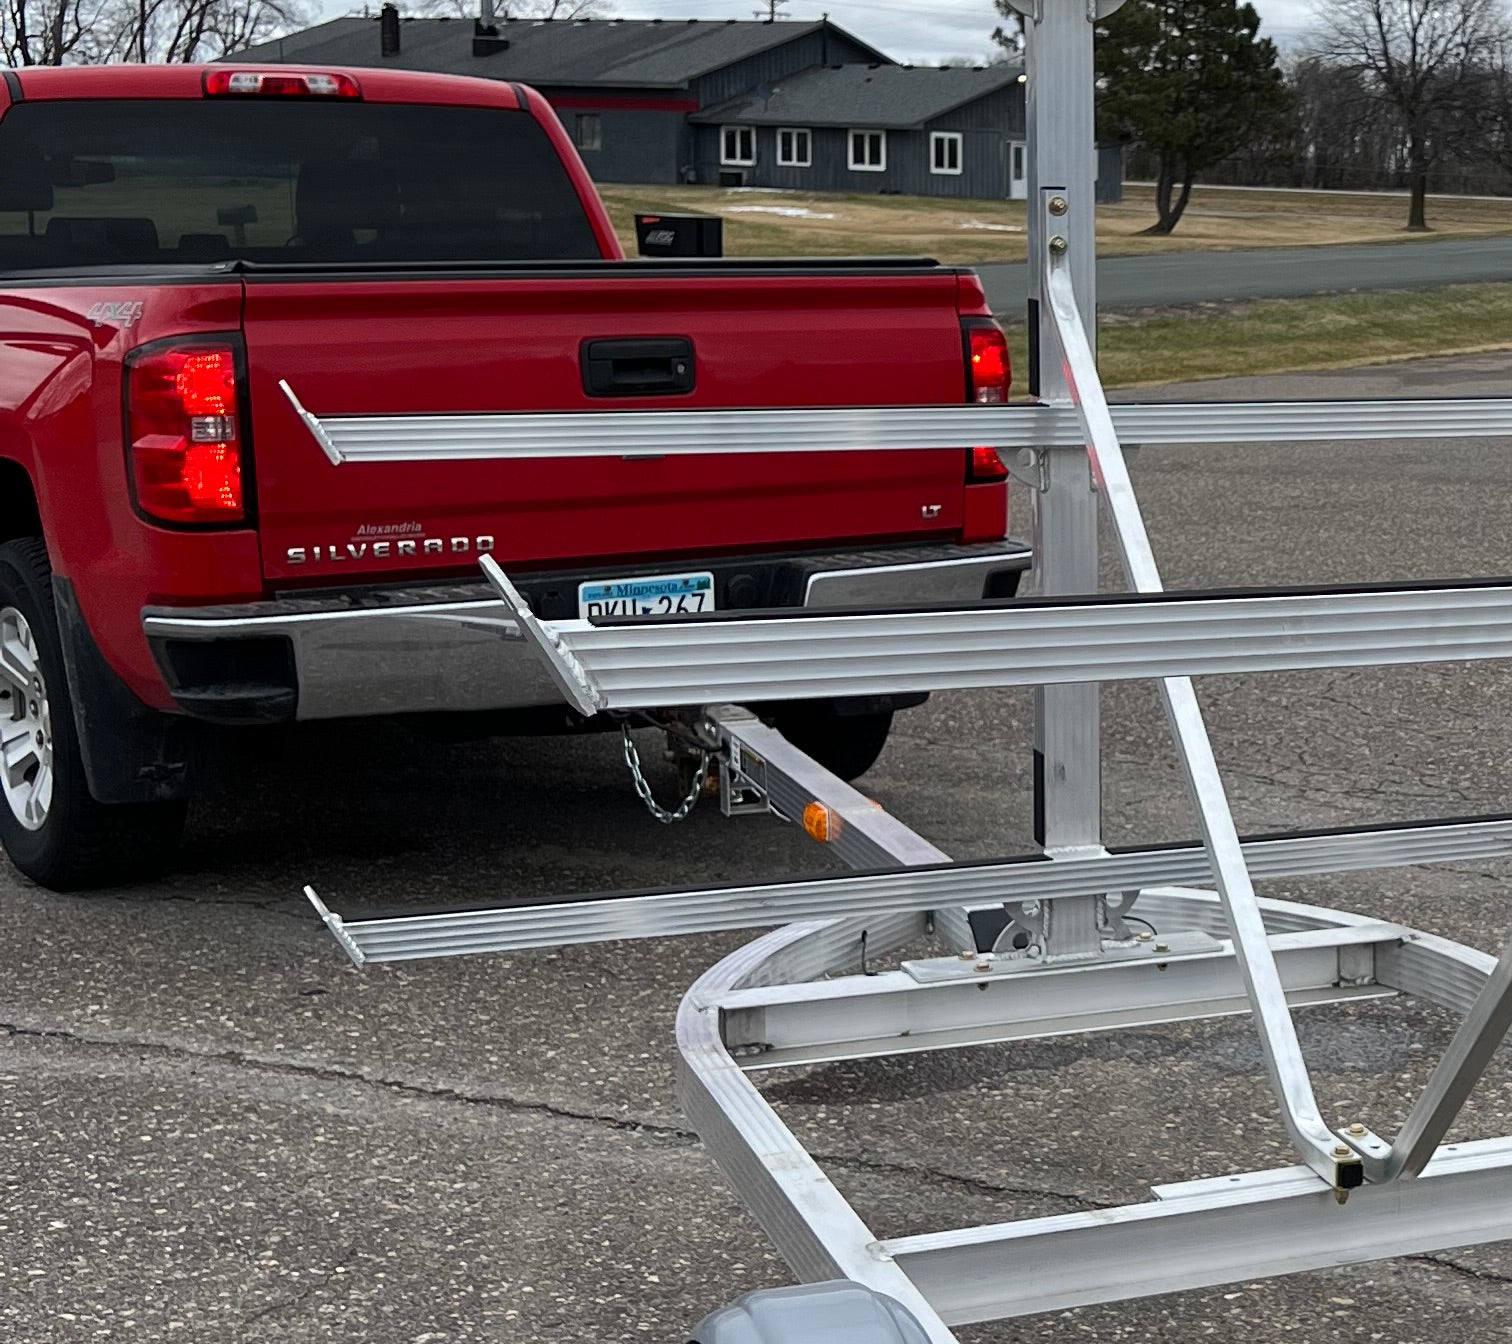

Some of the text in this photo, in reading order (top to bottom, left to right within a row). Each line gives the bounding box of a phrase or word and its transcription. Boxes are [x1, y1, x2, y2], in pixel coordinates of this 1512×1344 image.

[921, 504, 942, 519] LT
[357, 521, 422, 535] Alexandria
[287, 535, 494, 564] SILVERADO
[616, 579, 678, 597] Minnesota
